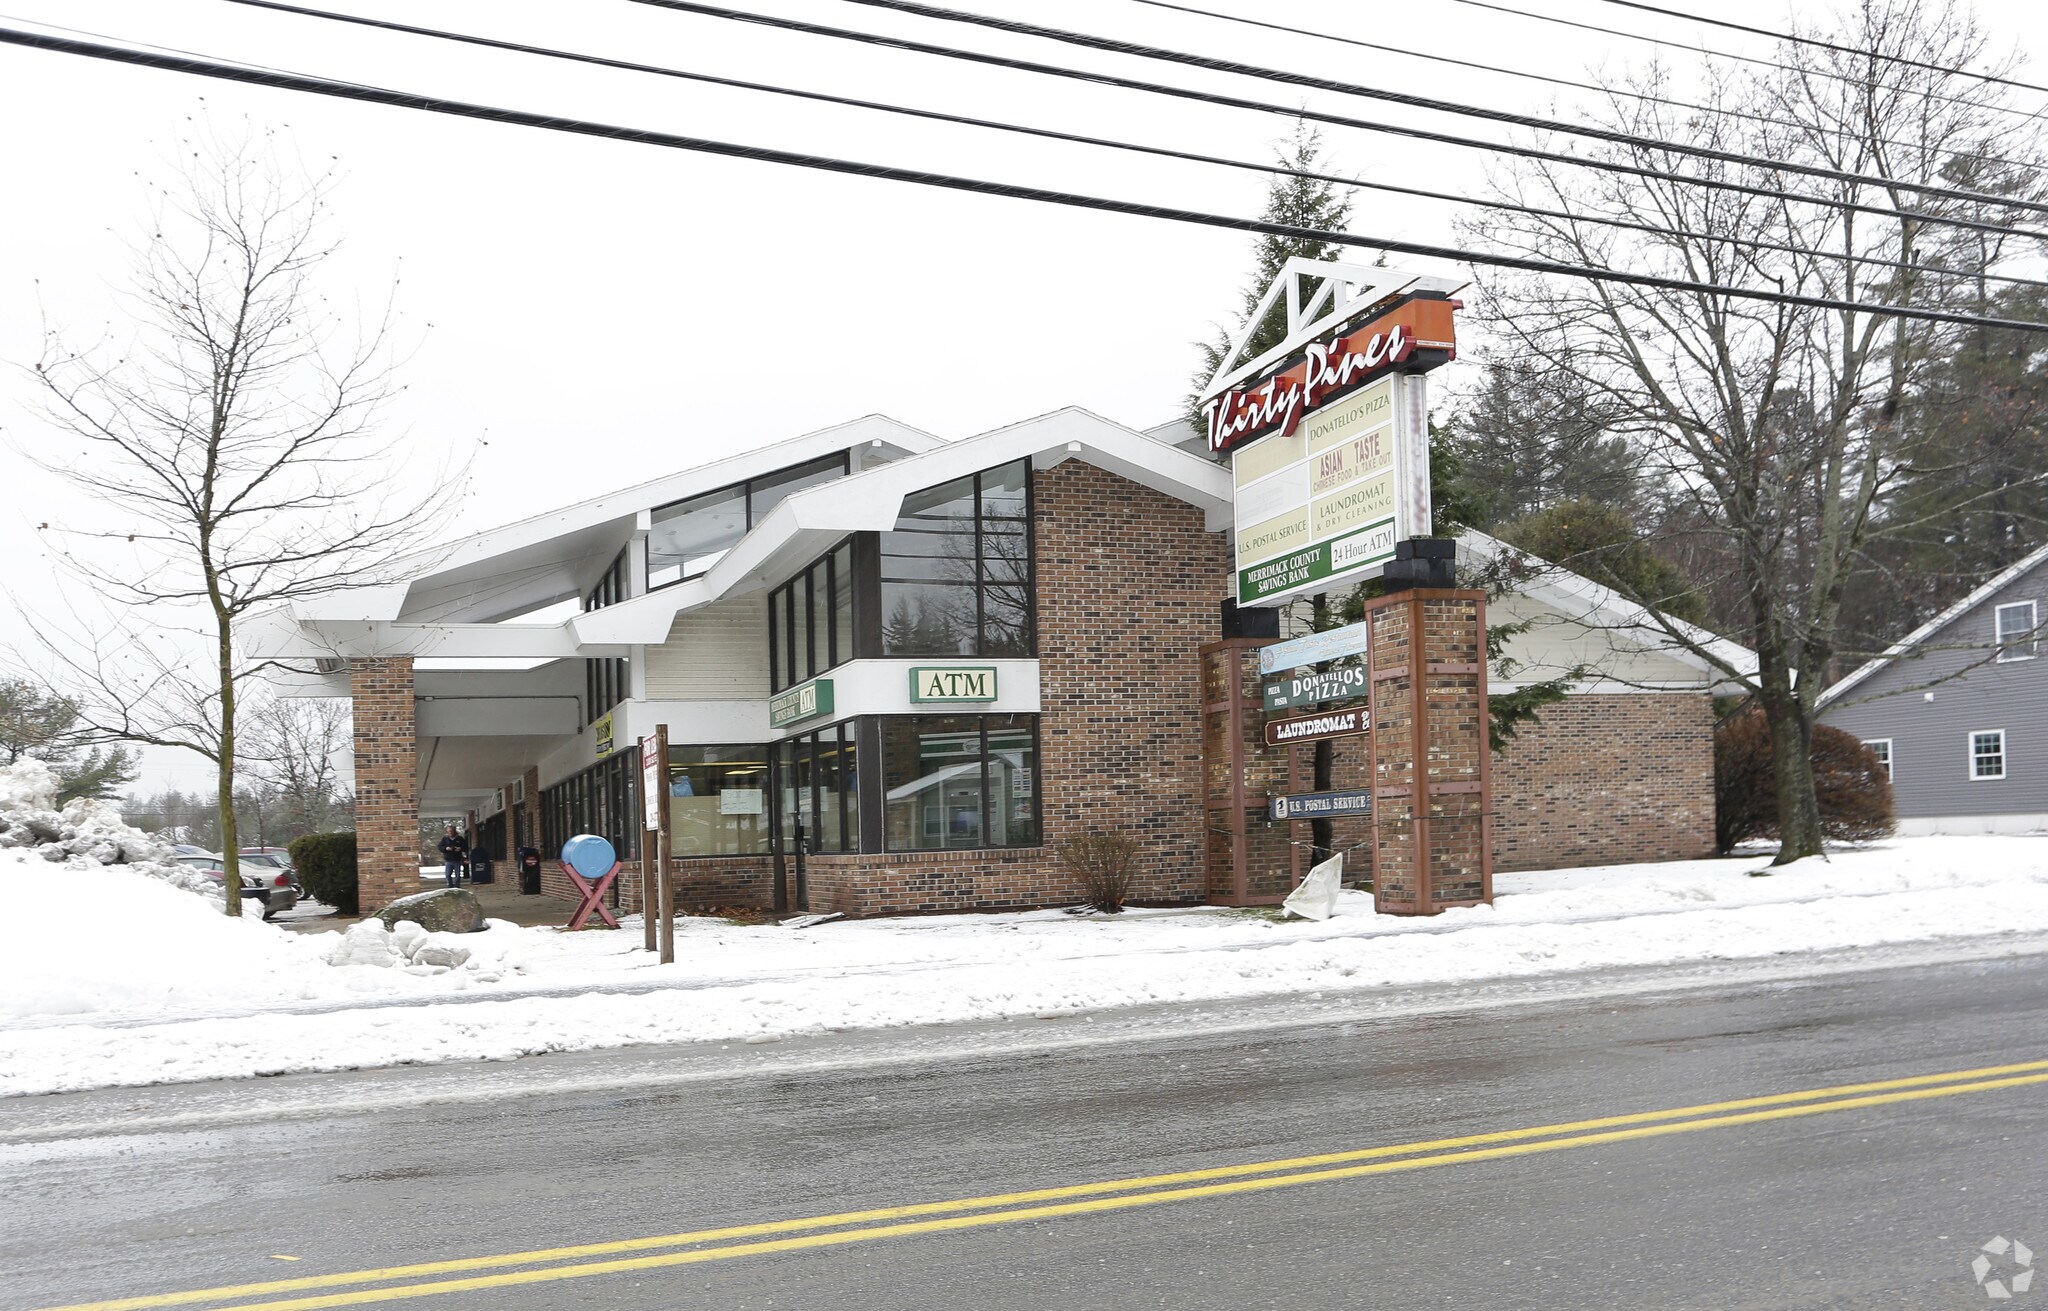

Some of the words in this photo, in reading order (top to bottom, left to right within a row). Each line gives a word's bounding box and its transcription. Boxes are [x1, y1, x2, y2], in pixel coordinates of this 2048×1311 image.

[1201, 375, 1300, 451] Thirty
[1303, 324, 1405, 407] Pines
[1310, 405, 1364, 441] DONATELLO'S
[1365, 394, 1390, 415] PIZZA
[1313, 475, 1336, 493] CHINESE
[1337, 468, 1353, 483] FOOD
[1361, 458, 1376, 472] TAKE
[1378, 451, 1391, 466] OUT
[1320, 449, 1343, 479] ASIAN
[1354, 432, 1380, 464] TASTE
[1316, 523, 1322, 532] &
[1325, 515, 1341, 528] DRY
[1345, 496, 1392, 520] CLEANING
[1320, 482, 1385, 518] LAUNDROMAT
[1239, 541, 1252, 554] U.S.
[1252, 531, 1278, 549] POSTAL
[1279, 519, 1307, 540] SERVICE
[1333, 547, 1343, 563] 24
[1344, 543, 1368, 560] Hour
[1369, 530, 1392, 552] ATM
[1247, 559, 1289, 584] MERRIMACK
[1289, 547, 1321, 570] COUNTY
[1257, 573, 1287, 594] SAVINGS
[1288, 565, 1310, 584] BANK
[926, 672, 986, 697] ATM
[1292, 667, 1364, 698] DONATELLOS
[1308, 682, 1348, 701] PIZZA
[800, 688, 815, 712] ATM
[1276, 713, 1356, 739] LAUNDROMAT
[1289, 800, 1302, 813] U.S.
[1304, 798, 1332, 812] POSTAL
[1333, 795, 1366, 809] SERVICE
